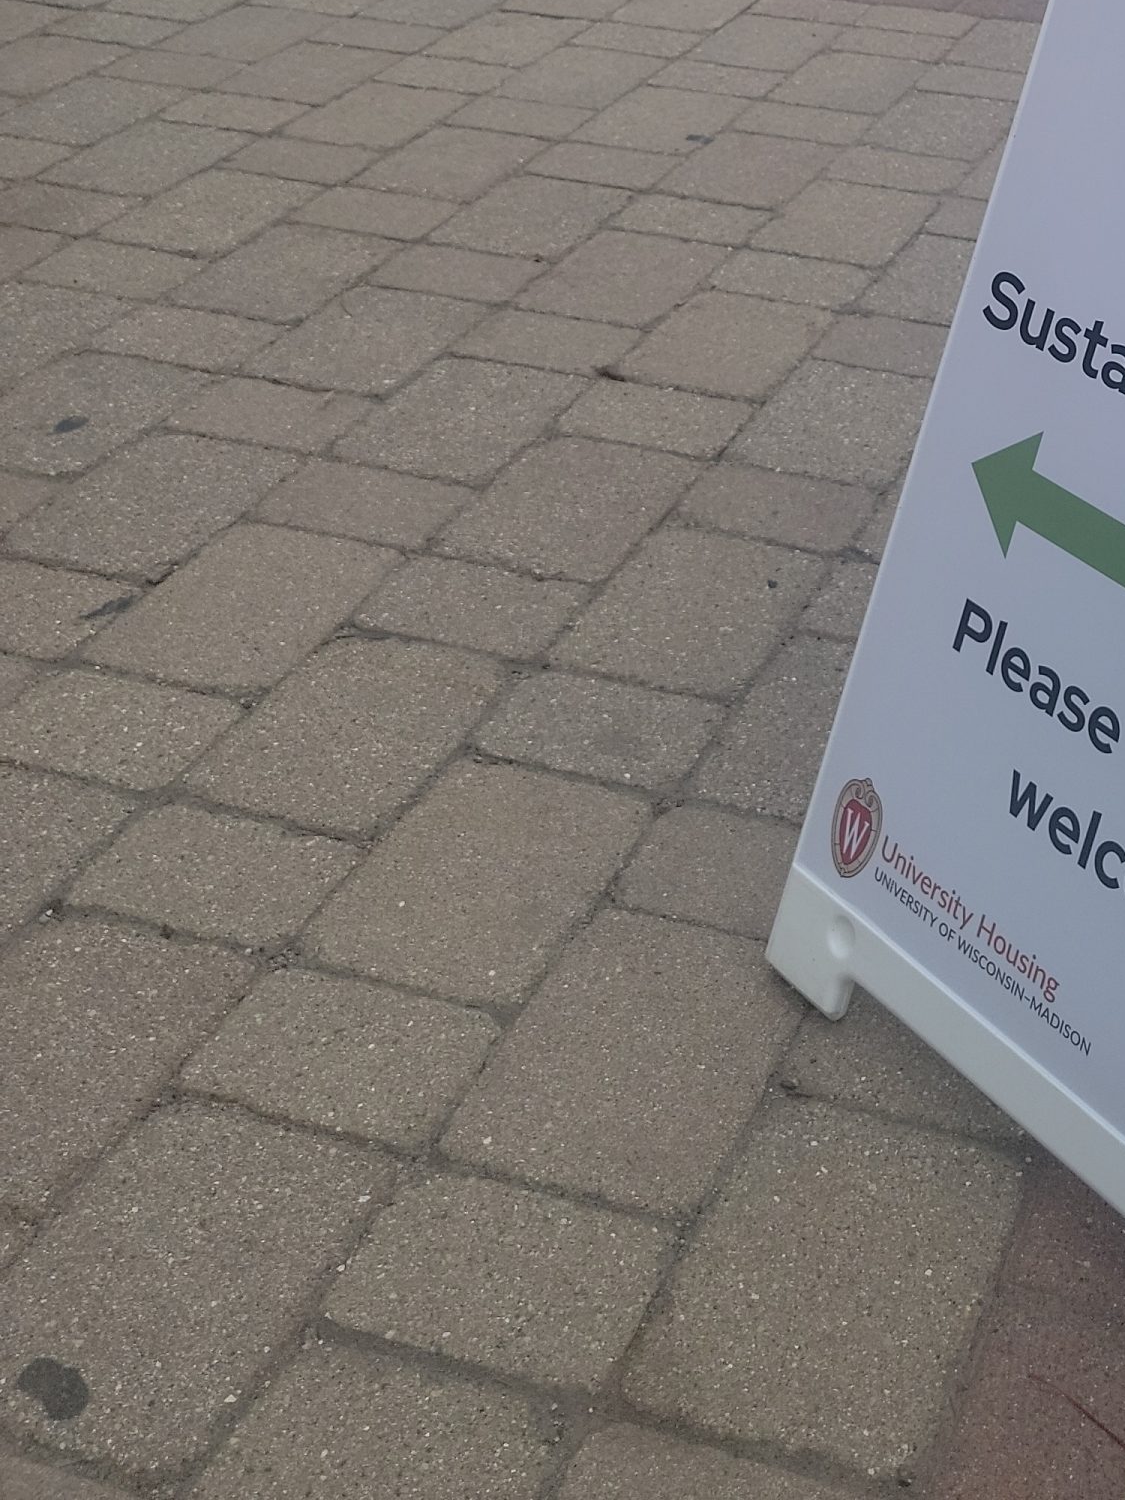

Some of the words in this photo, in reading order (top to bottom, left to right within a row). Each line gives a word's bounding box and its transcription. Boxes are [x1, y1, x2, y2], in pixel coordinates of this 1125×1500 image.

[952, 598, 1121, 754] Please
[873, 866, 938, 928] UNIVERSITY
[938, 921, 957, 942] OF
[881, 835, 974, 930] University
[976, 913, 1061, 1003] Housing
